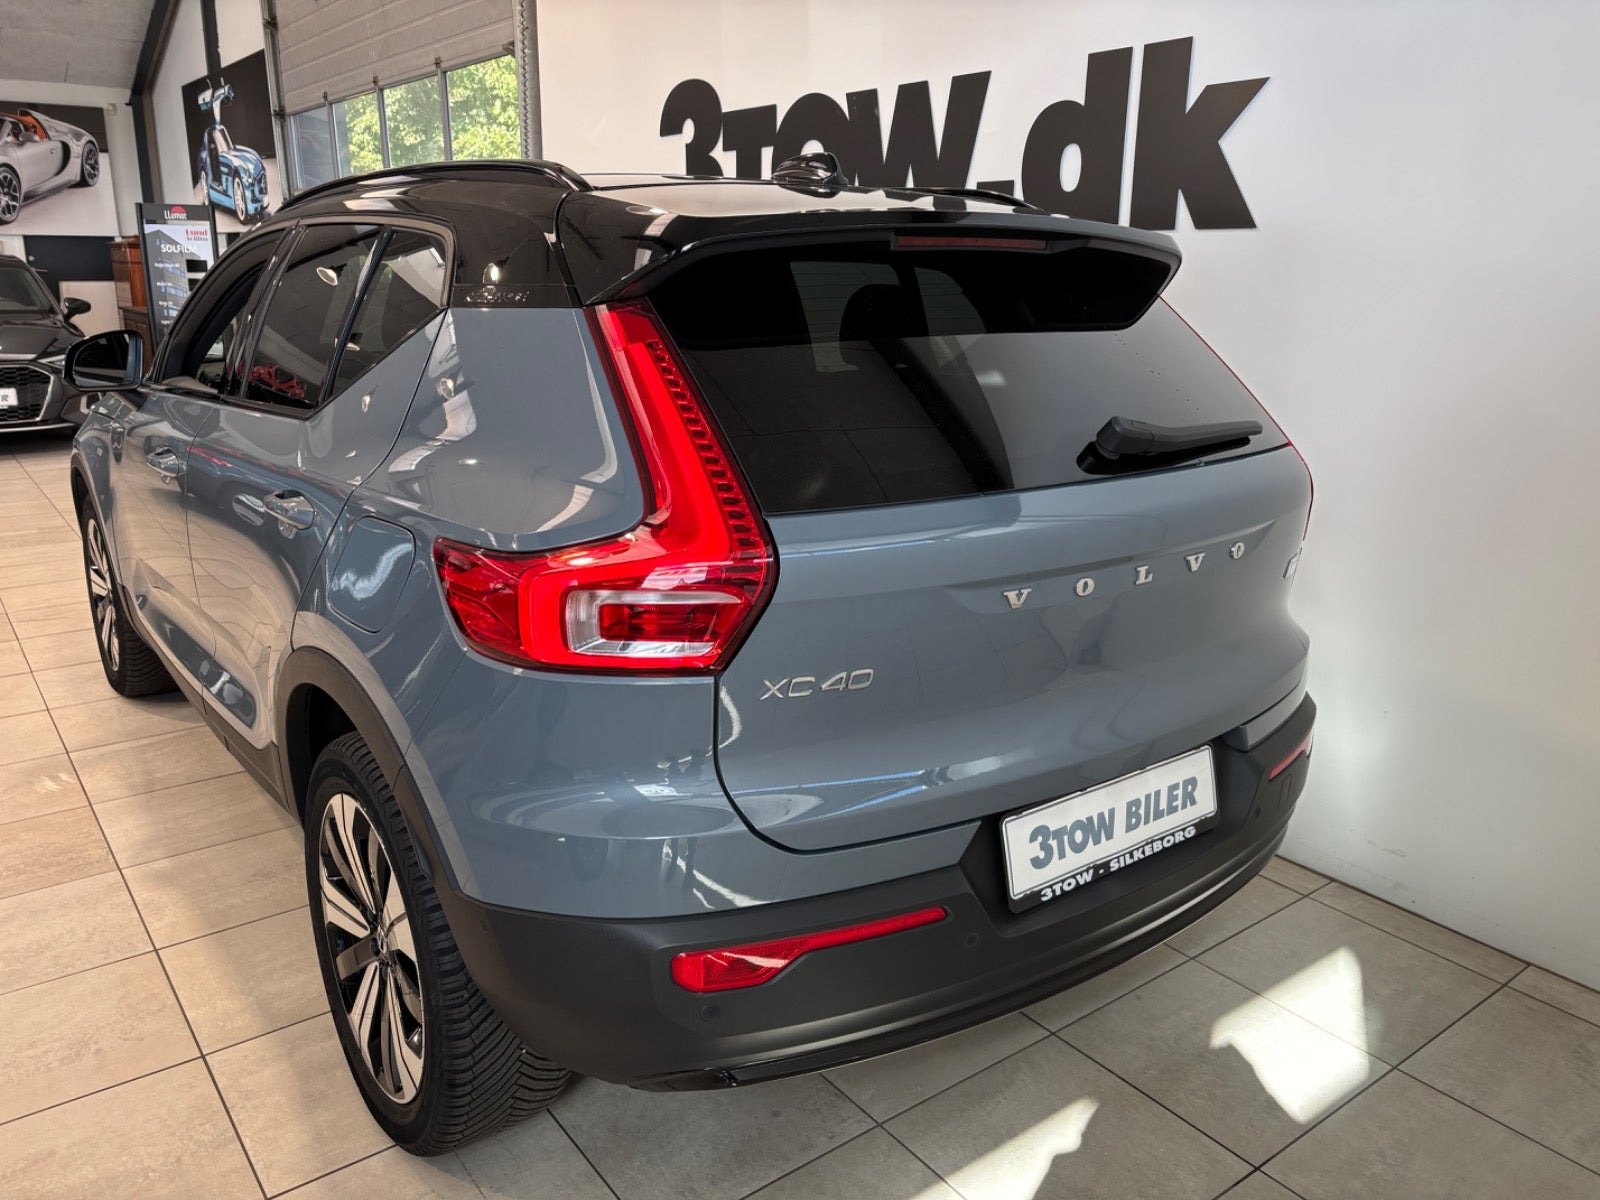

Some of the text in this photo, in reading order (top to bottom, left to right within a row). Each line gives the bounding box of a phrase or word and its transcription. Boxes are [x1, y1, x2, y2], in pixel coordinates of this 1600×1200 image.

[1003, 541, 1245, 610] VOLVO
[1029, 775, 1199, 871] 3TOW BILER
[1040, 868, 1094, 902] 3TOW
[1109, 825, 1197, 872] SILKEBORG
